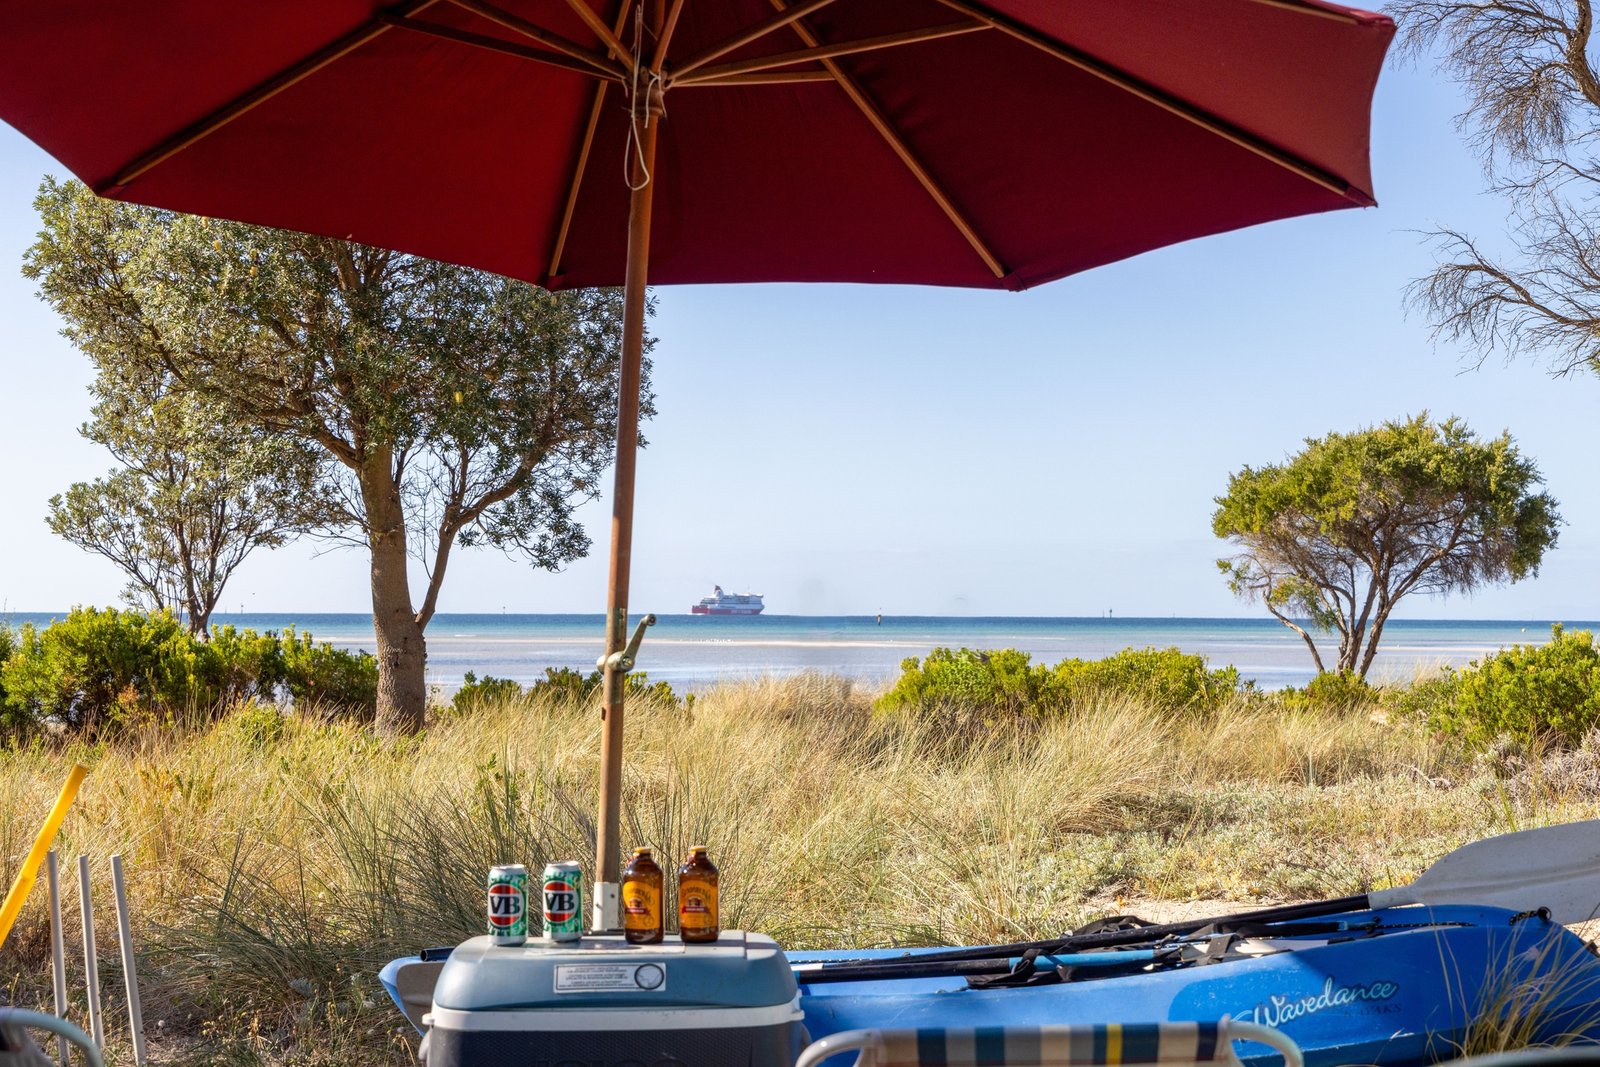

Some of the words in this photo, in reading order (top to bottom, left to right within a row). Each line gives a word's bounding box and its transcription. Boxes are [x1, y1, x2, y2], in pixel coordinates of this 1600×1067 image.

[489, 895, 521, 915] VB
[545, 892, 575, 911] VB
[1252, 976, 1398, 1028] Wavedance
